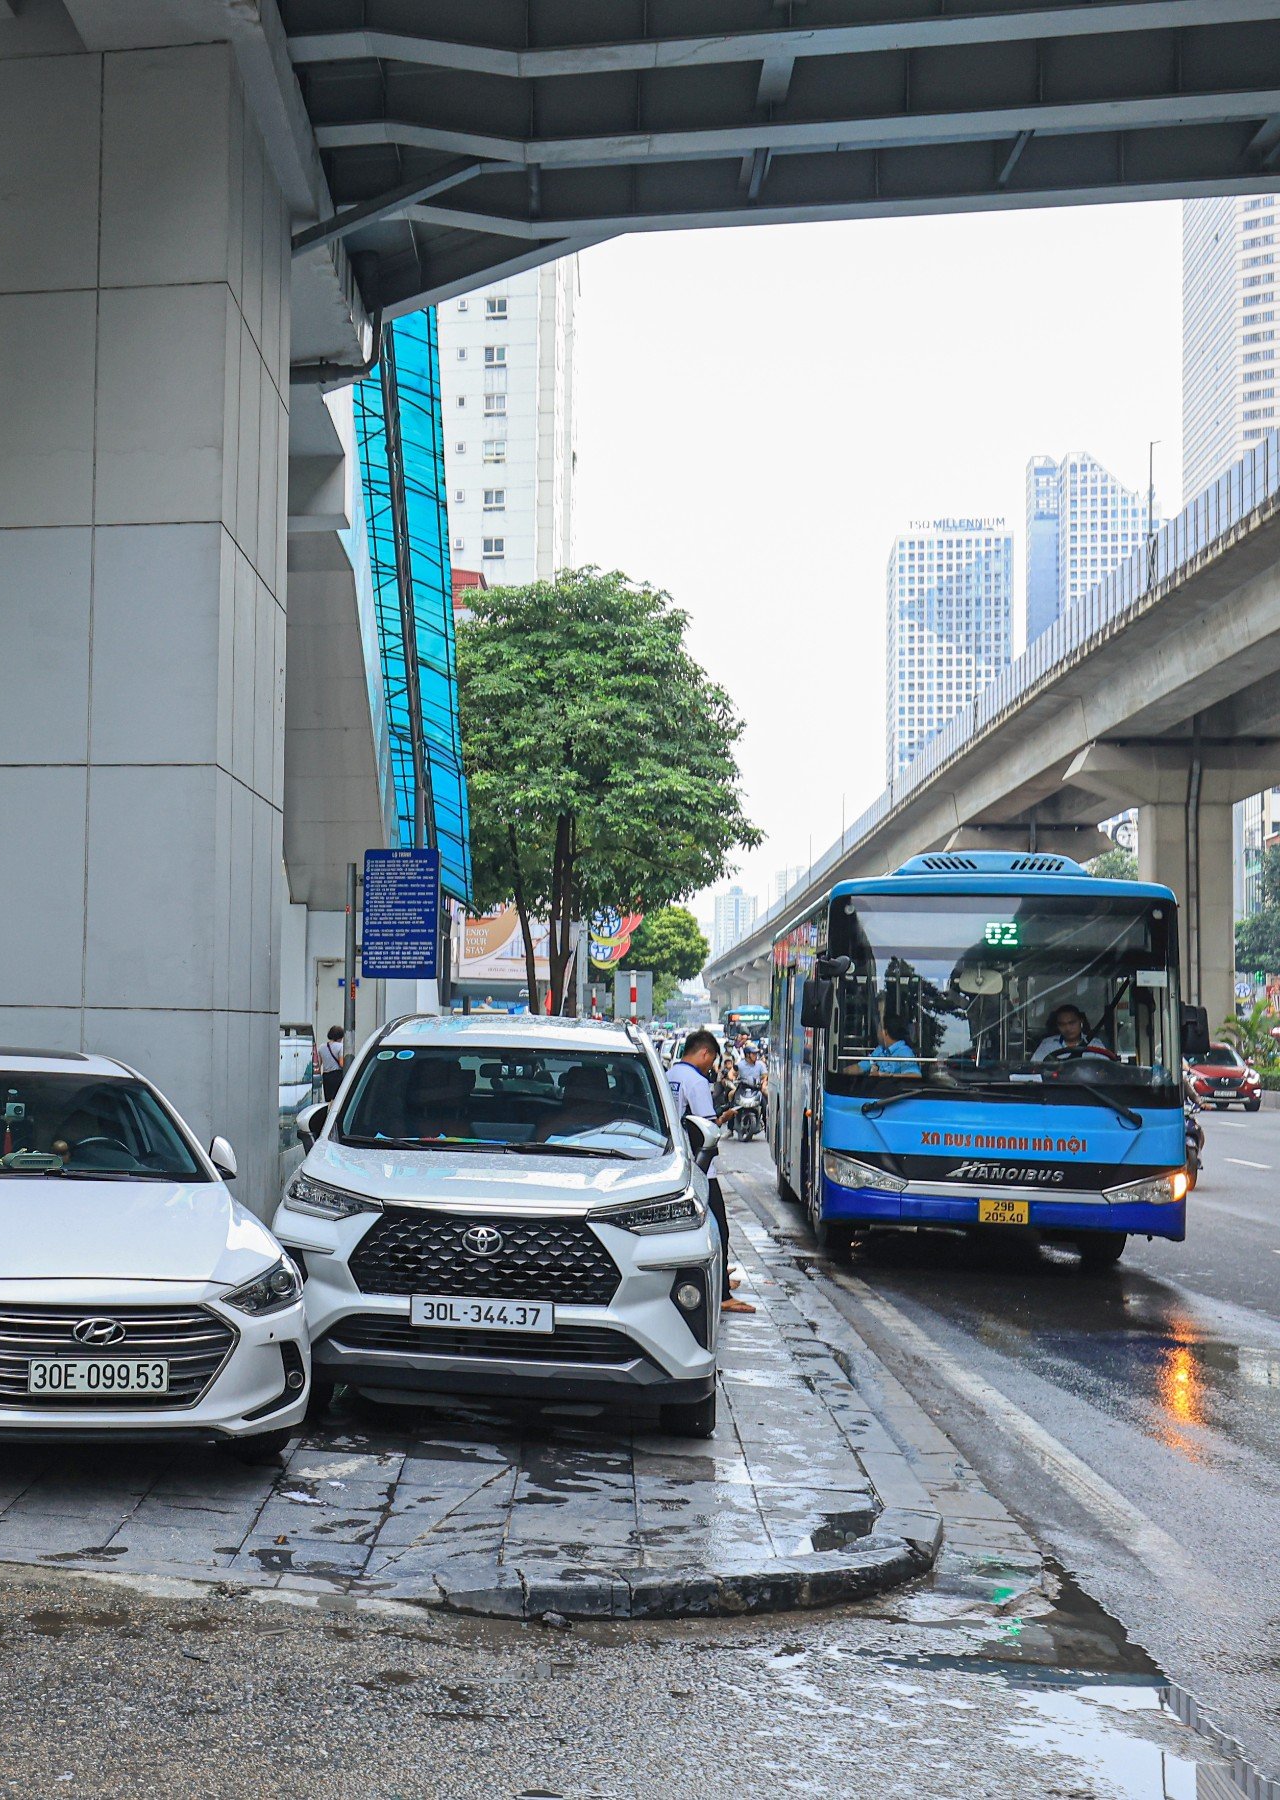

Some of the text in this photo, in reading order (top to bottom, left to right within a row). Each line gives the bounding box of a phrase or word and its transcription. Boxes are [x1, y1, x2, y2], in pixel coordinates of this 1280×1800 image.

[933, 517, 1005, 530] MILLENNIUM
[985, 922, 1018, 945] 02
[465, 947, 485, 955] STAY
[943, 1133, 972, 1148] BUS
[975, 1135, 1029, 1151] NHANH
[1032, 1135, 1054, 1152] HÀ
[1056, 1136, 1088, 1155] NỘI
[993, 1201, 1015, 1212] 29B
[984, 1212, 1024, 1223] 205.40
[423, 1302, 541, 1326] 30L-344.37
[33, 1363, 164, 1390] 30E-099.53
